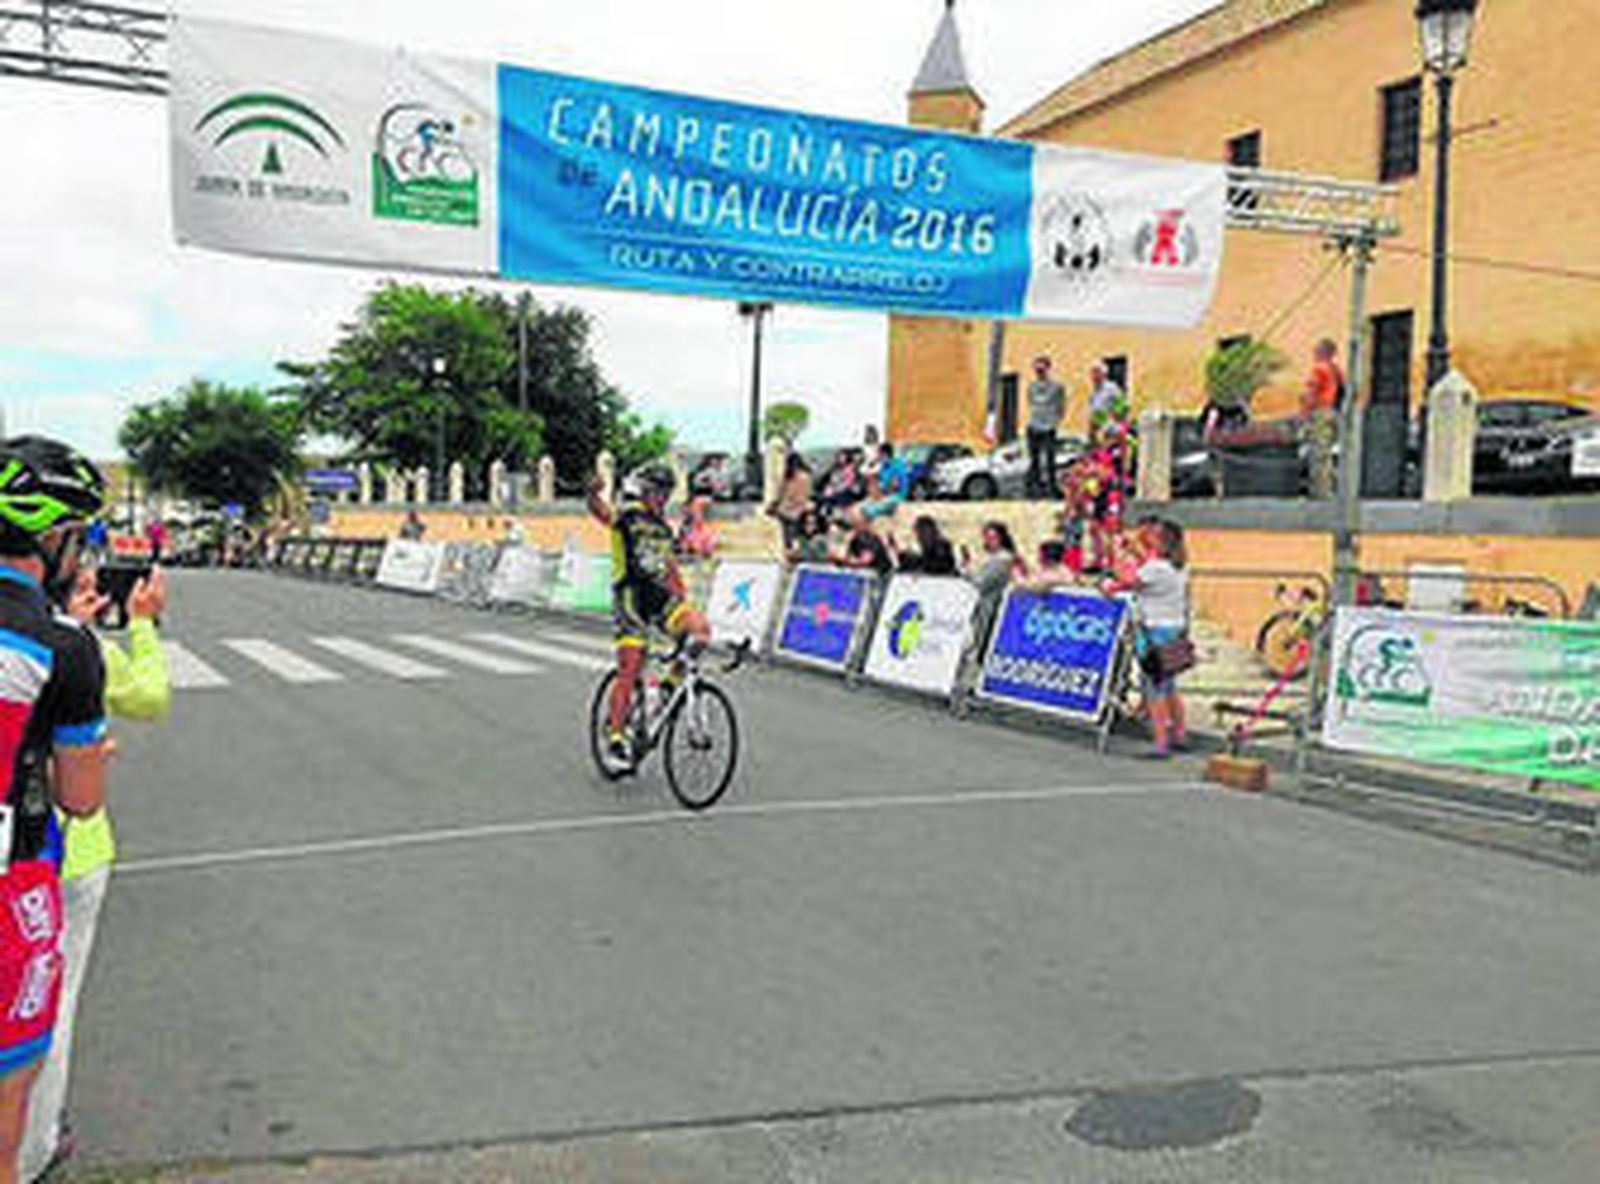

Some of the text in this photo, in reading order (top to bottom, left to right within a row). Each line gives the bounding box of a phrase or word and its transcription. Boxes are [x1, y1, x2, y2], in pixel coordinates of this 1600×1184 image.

[547, 98, 948, 194] CAMPEONATOS
[556, 159, 600, 188] DE
[604, 168, 879, 244] ANDALUCÍA
[889, 206, 997, 256] 2016
[610, 242, 696, 272] RUTA
[703, 251, 725, 271] Y
